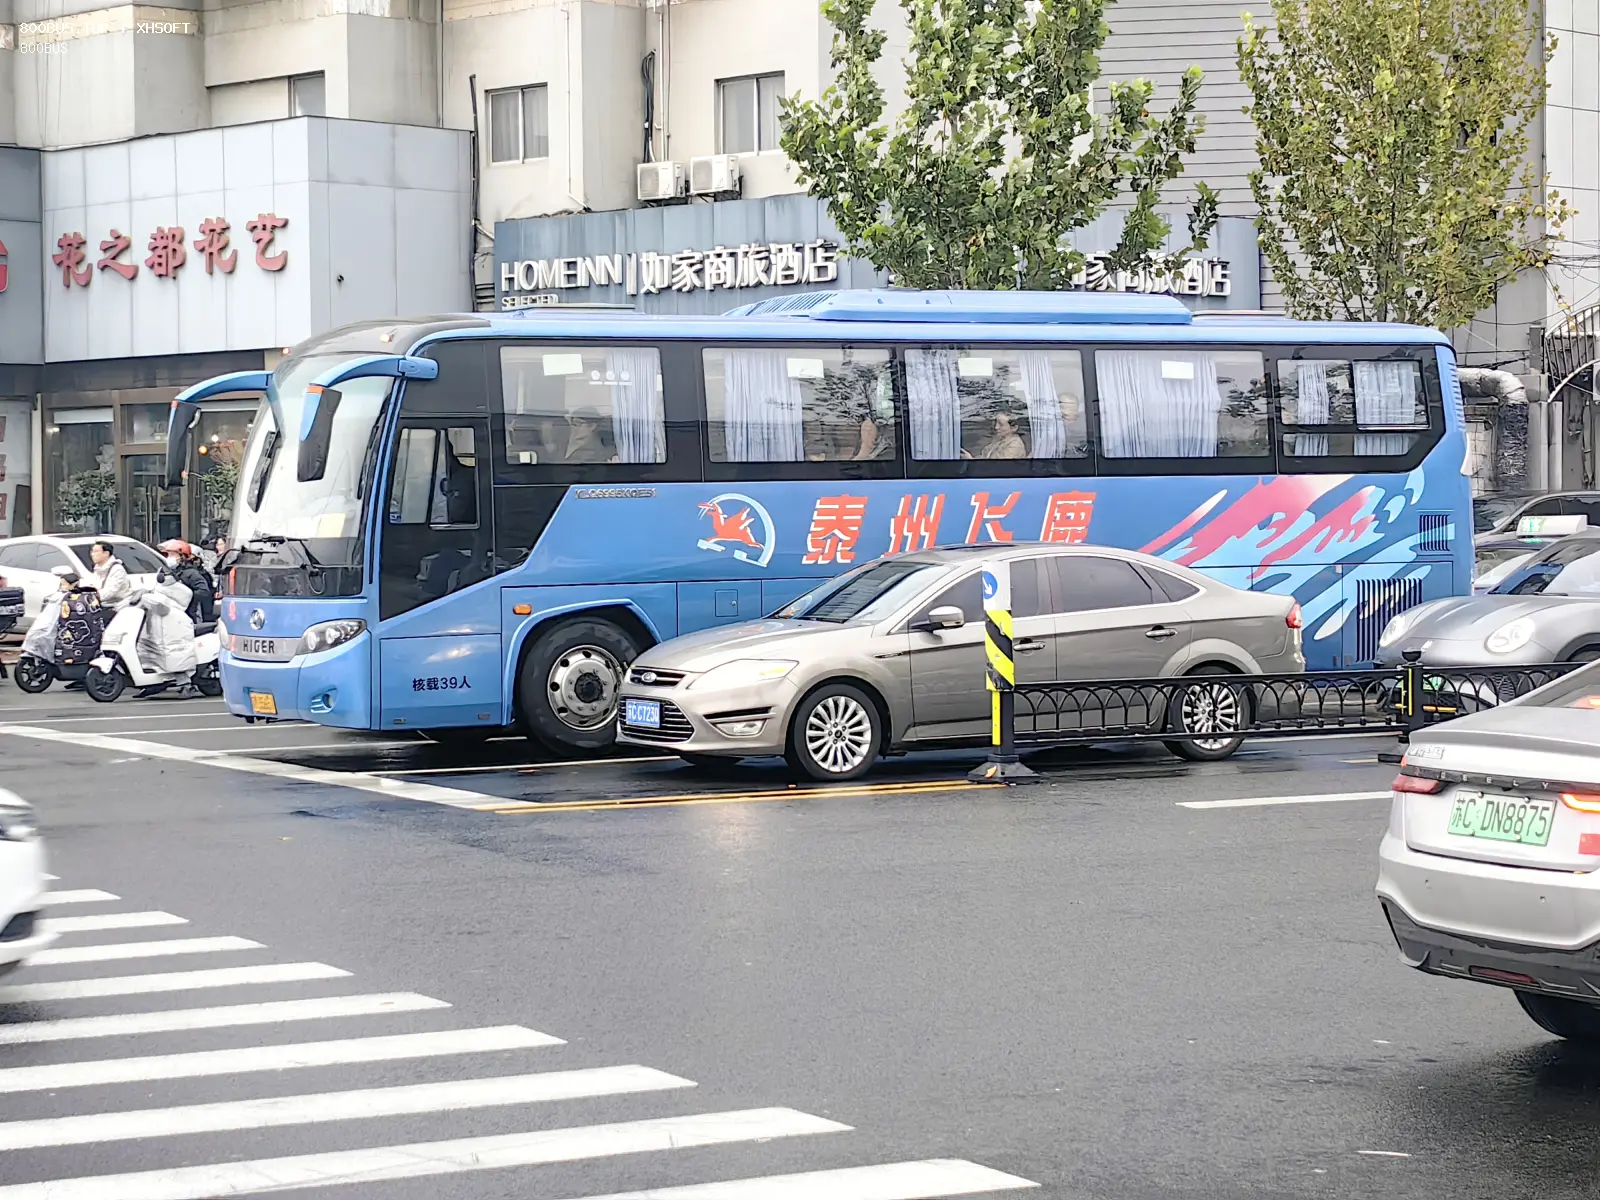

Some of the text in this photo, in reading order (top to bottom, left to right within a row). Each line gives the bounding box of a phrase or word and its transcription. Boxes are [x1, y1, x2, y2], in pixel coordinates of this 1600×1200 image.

[52, 212, 289, 288] 花之都花艺
[501, 239, 839, 294] HOMEINN 如家商旅酒店
[243, 640, 275, 654] HIGER
[412, 675, 472, 692] 核载39人
